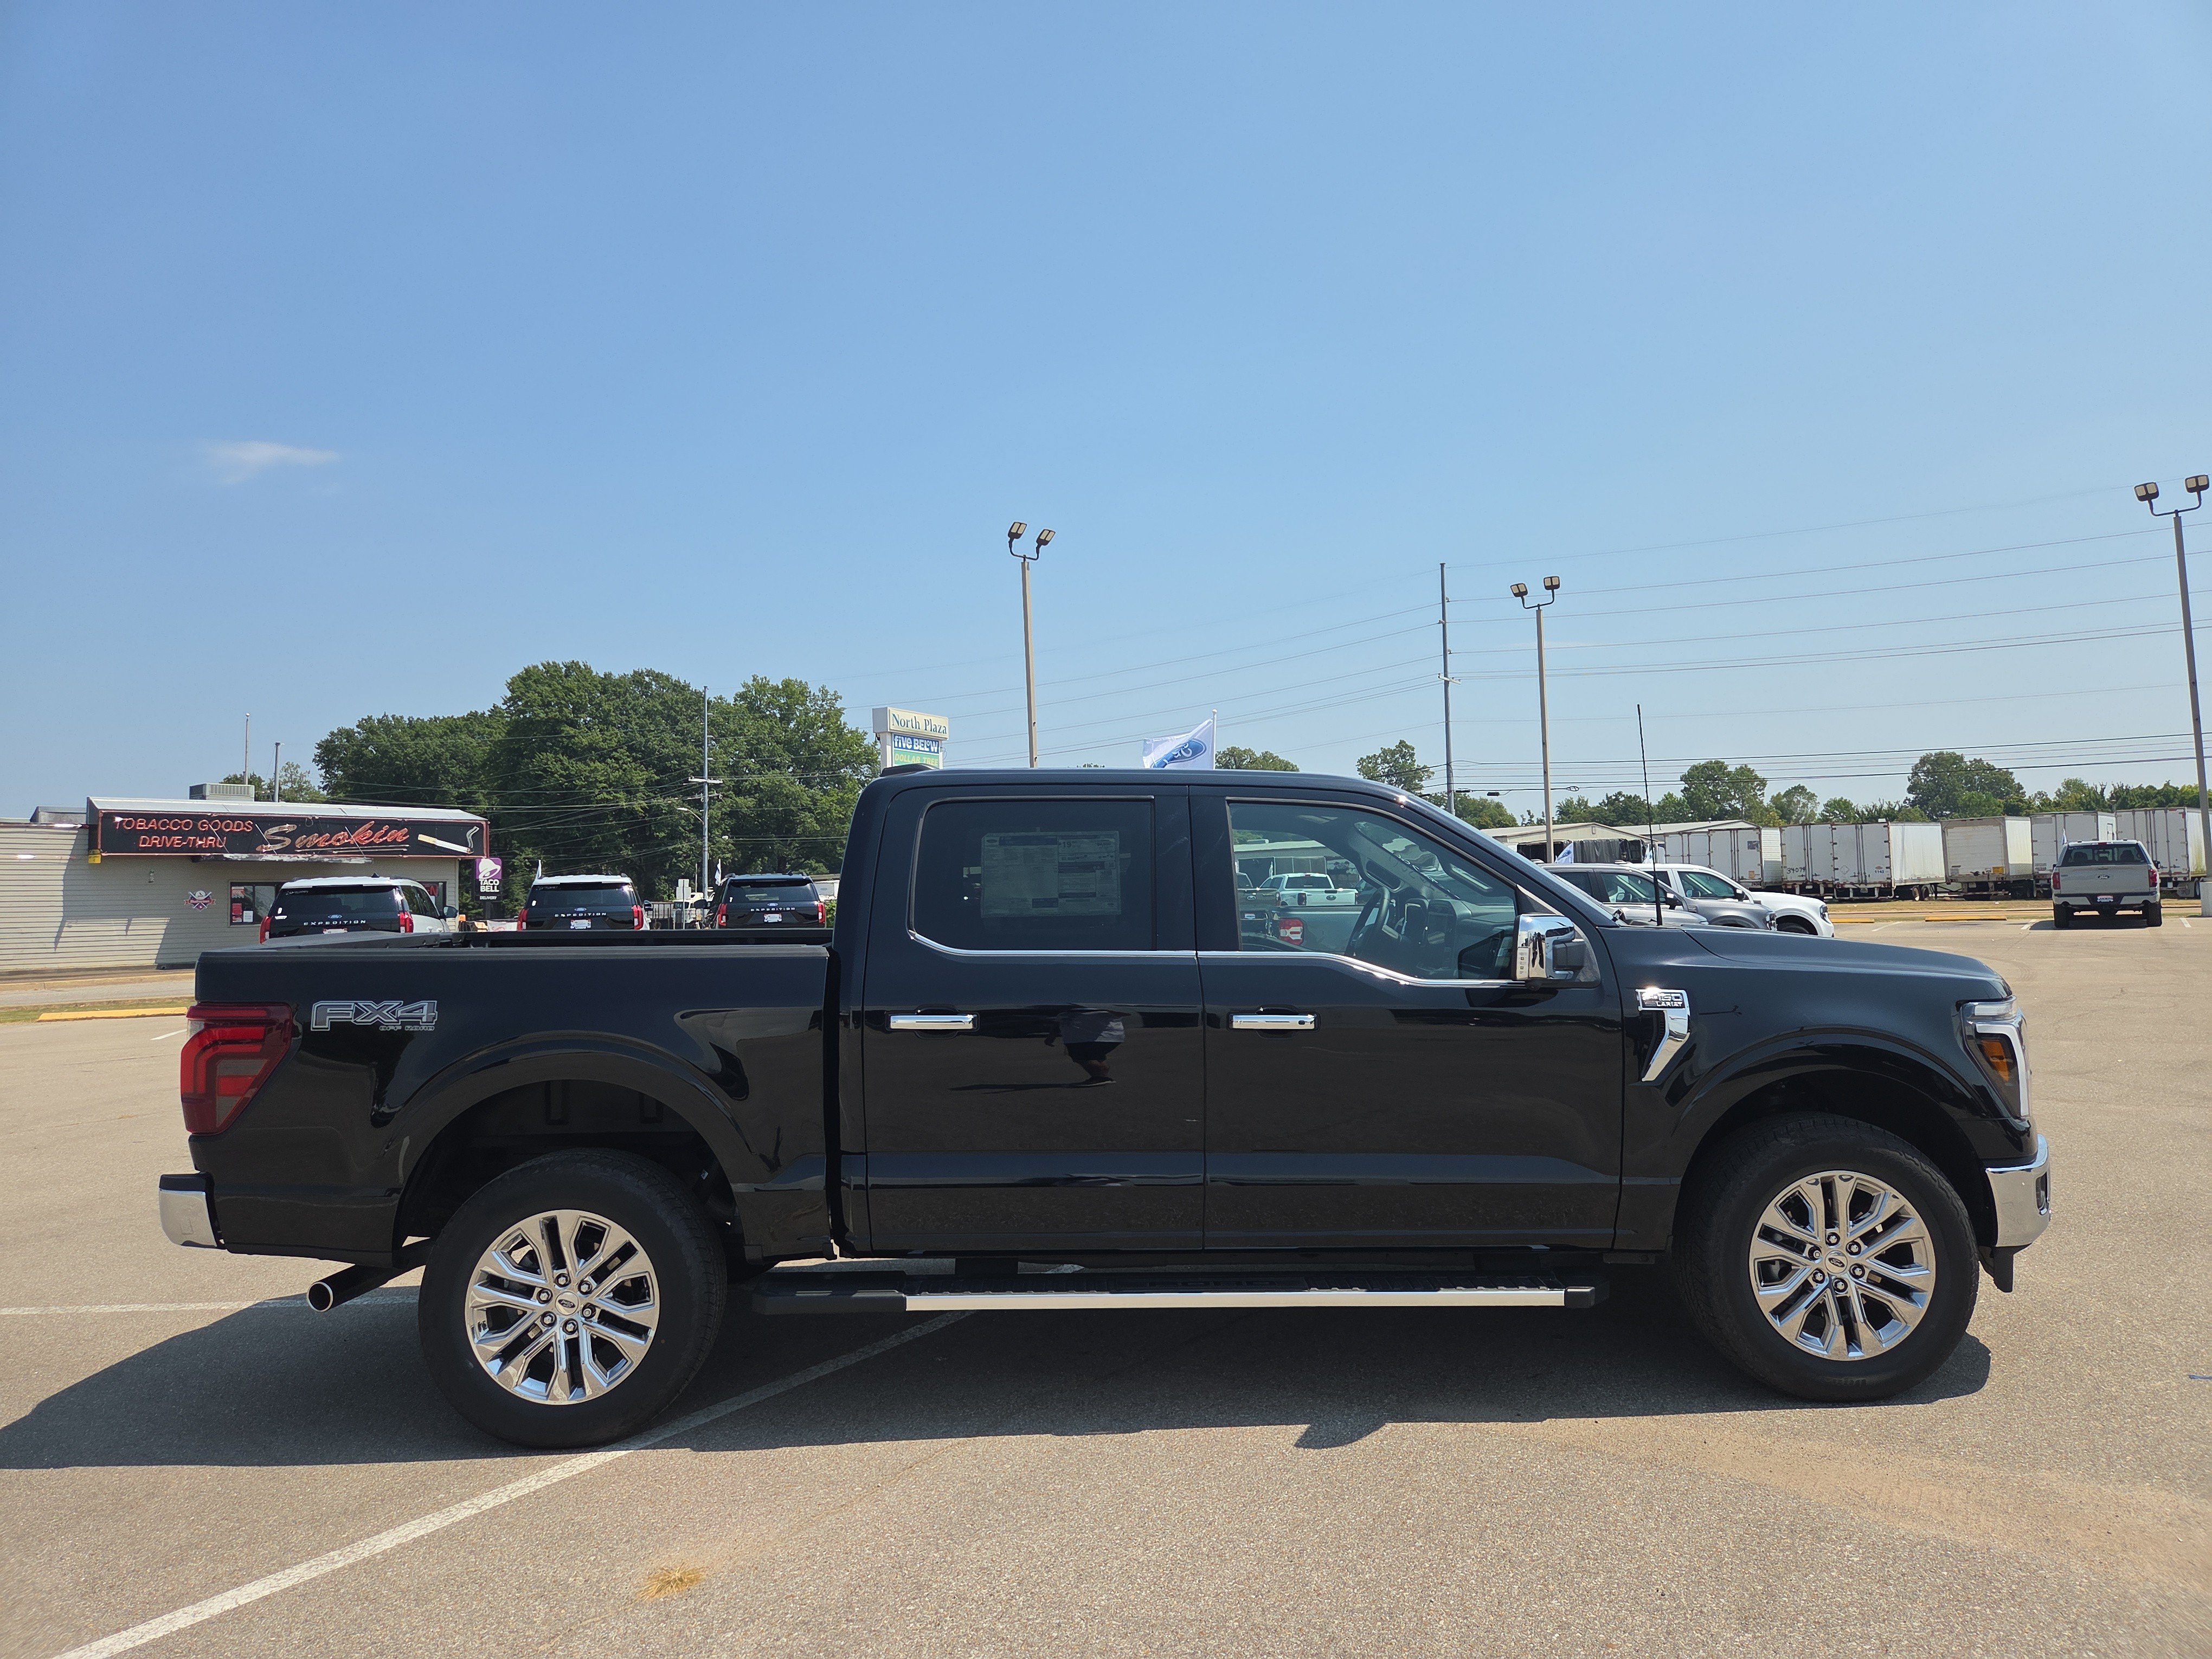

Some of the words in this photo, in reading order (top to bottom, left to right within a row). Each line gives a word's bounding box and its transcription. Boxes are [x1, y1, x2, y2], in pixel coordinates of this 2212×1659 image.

[892, 713, 920, 730] North
[924, 718, 947, 735] Plaza
[895, 735, 912, 749] five
[913, 738, 938, 753] BELOW
[895, 753, 921, 763] DOLLAR
[923, 757, 938, 766] TREE
[113, 818, 193, 830] TOBACCO
[197, 819, 253, 832] GOODS
[139, 835, 227, 848] DRIVE-THRU
[256, 821, 409, 851] Smokin
[311, 1001, 438, 1031] FX4
